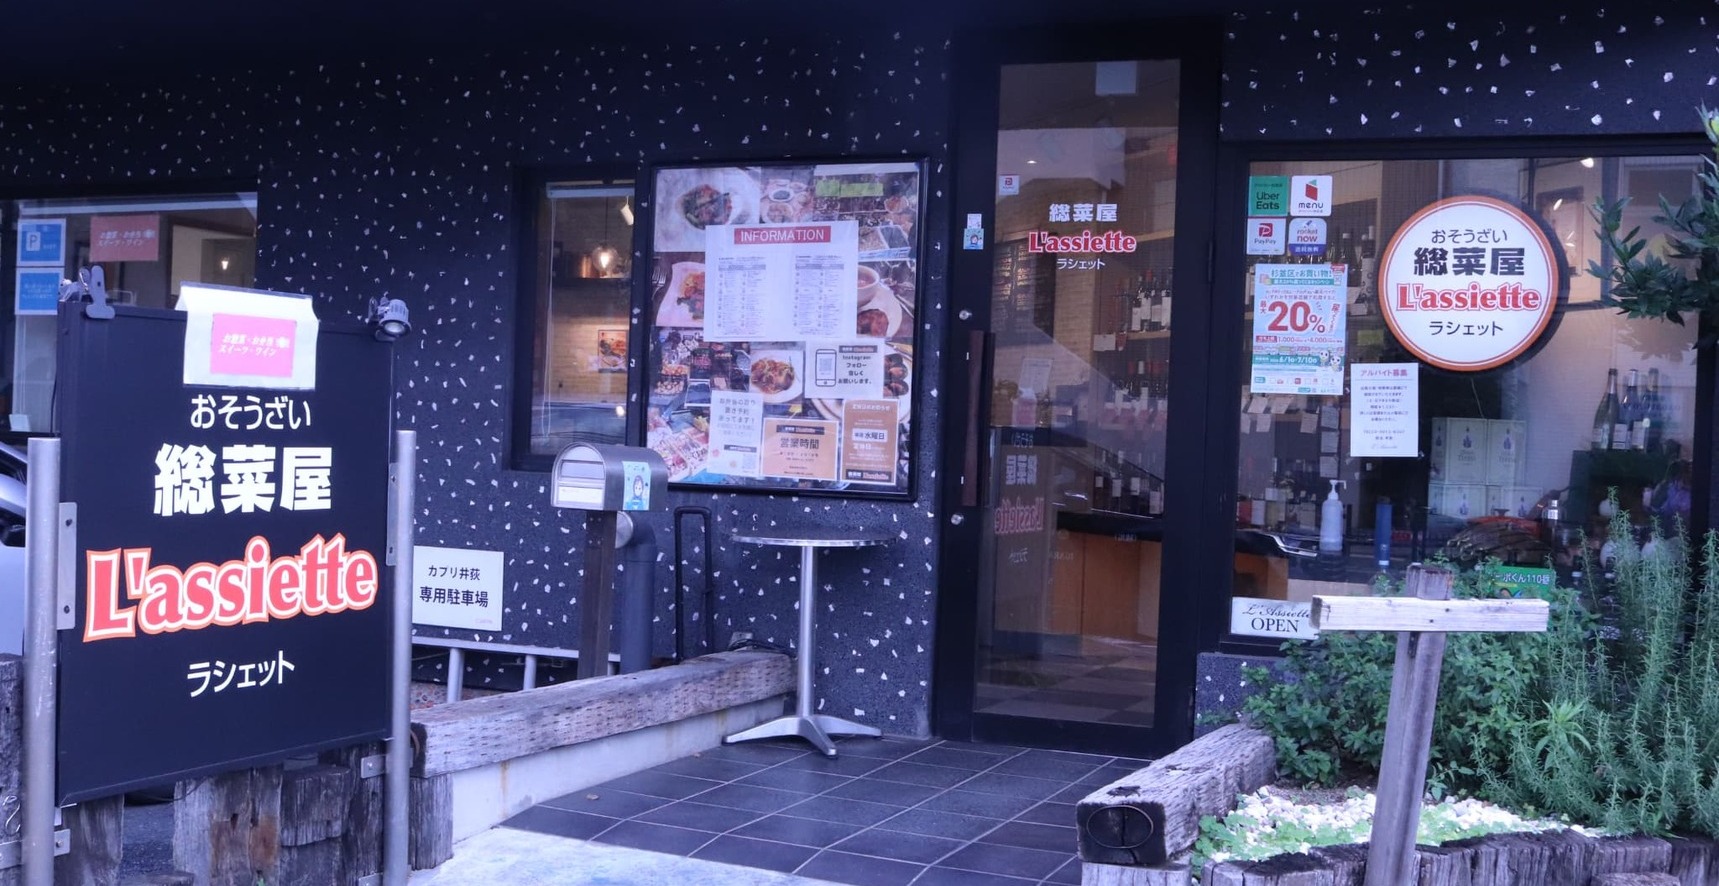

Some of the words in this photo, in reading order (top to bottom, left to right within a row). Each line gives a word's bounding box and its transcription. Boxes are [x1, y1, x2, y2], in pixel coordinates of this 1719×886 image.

[1256, 191, 1280, 200] Uber
[1049, 203, 1118, 222] 総菜屋
[1256, 201, 1280, 210] Eats
[740, 229, 825, 242] INFORMATION
[1028, 230, 1136, 253] L'assiette
[1297, 235, 1318, 243] now
[1431, 229, 1508, 244] おそうざい
[1056, 258, 1106, 270] ラシェット
[1413, 247, 1525, 276] 総菜屋
[1396, 281, 1541, 311] L'assiette
[1268, 301, 1325, 333] 20%
[1429, 320, 1504, 336] ラシェット
[190, 394, 311, 430] おそうざい
[780, 438, 820, 449] 営業時間
[153, 443, 332, 517] 総菜屋
[83, 532, 378, 643] L'assiette
[419, 586, 489, 608] 専用駐車場
[1251, 618, 1299, 633] OPEN
[187, 650, 295, 698] ラシェット
